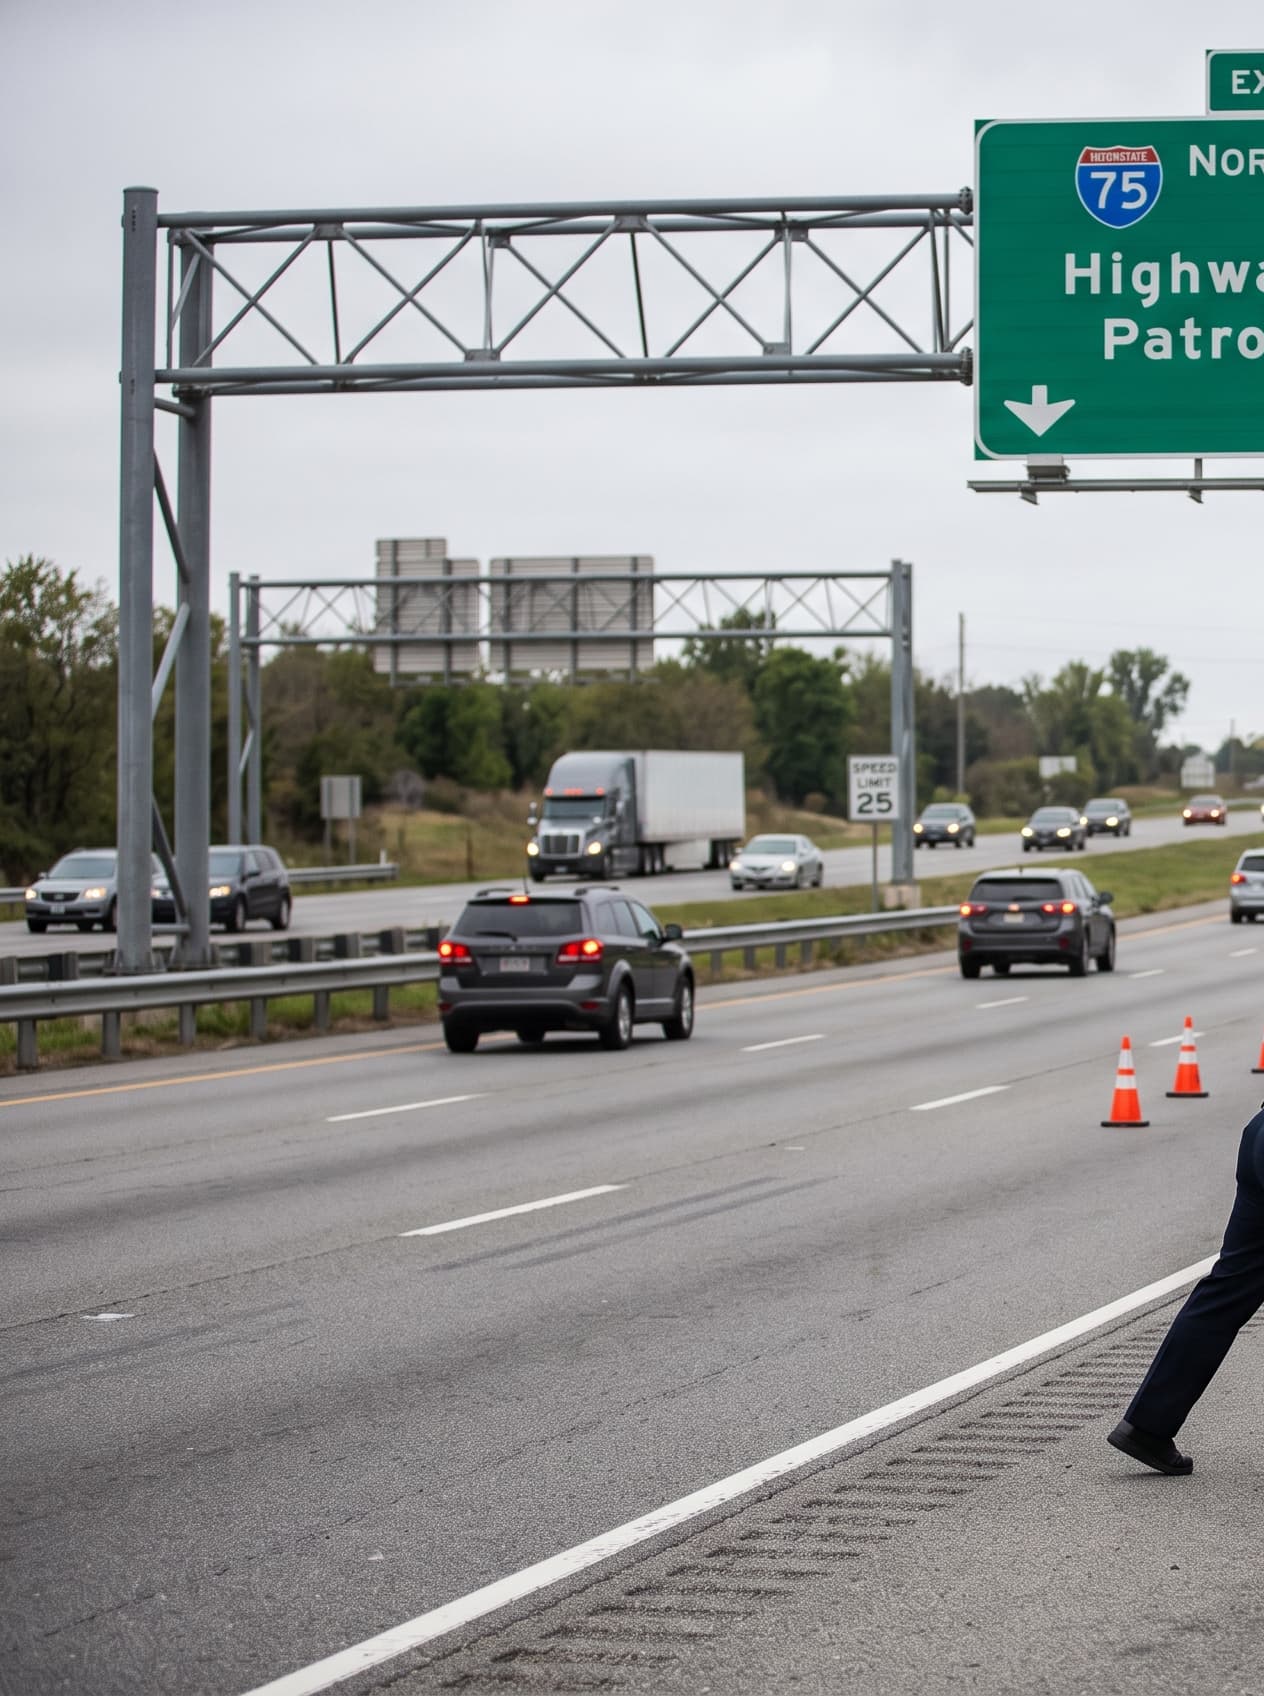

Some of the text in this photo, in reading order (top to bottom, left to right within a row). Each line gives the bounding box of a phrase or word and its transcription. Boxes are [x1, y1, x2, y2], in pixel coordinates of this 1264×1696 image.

[1090, 171, 1148, 210] 75
[853, 762, 897, 773] SPEED
[856, 777, 892, 788] LIMIT
[857, 792, 893, 814] 25
